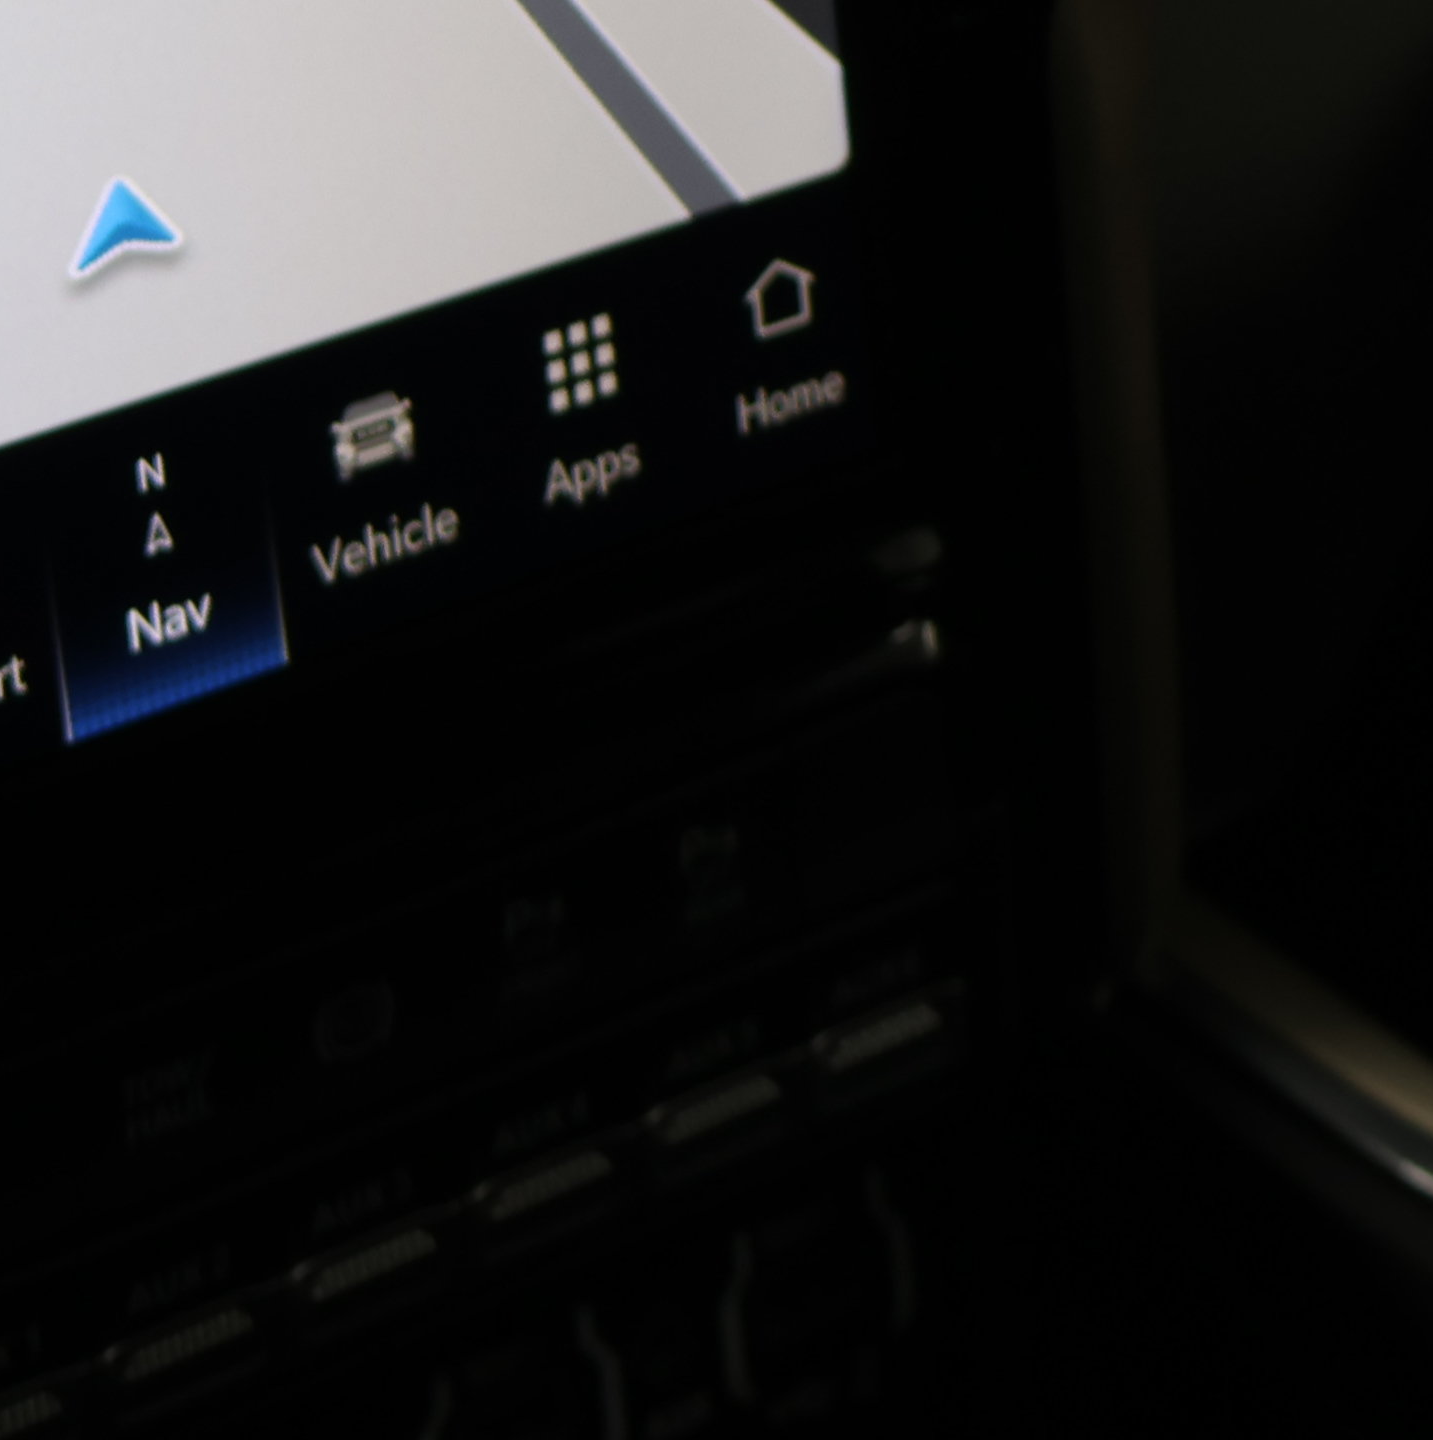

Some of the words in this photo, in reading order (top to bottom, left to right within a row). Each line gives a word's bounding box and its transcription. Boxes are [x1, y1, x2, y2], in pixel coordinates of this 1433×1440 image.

[737, 369, 846, 437] Home
[136, 453, 166, 494] N
[543, 440, 643, 509] Apps
[310, 502, 460, 585] Vehicle
[126, 592, 212, 654] Nav
